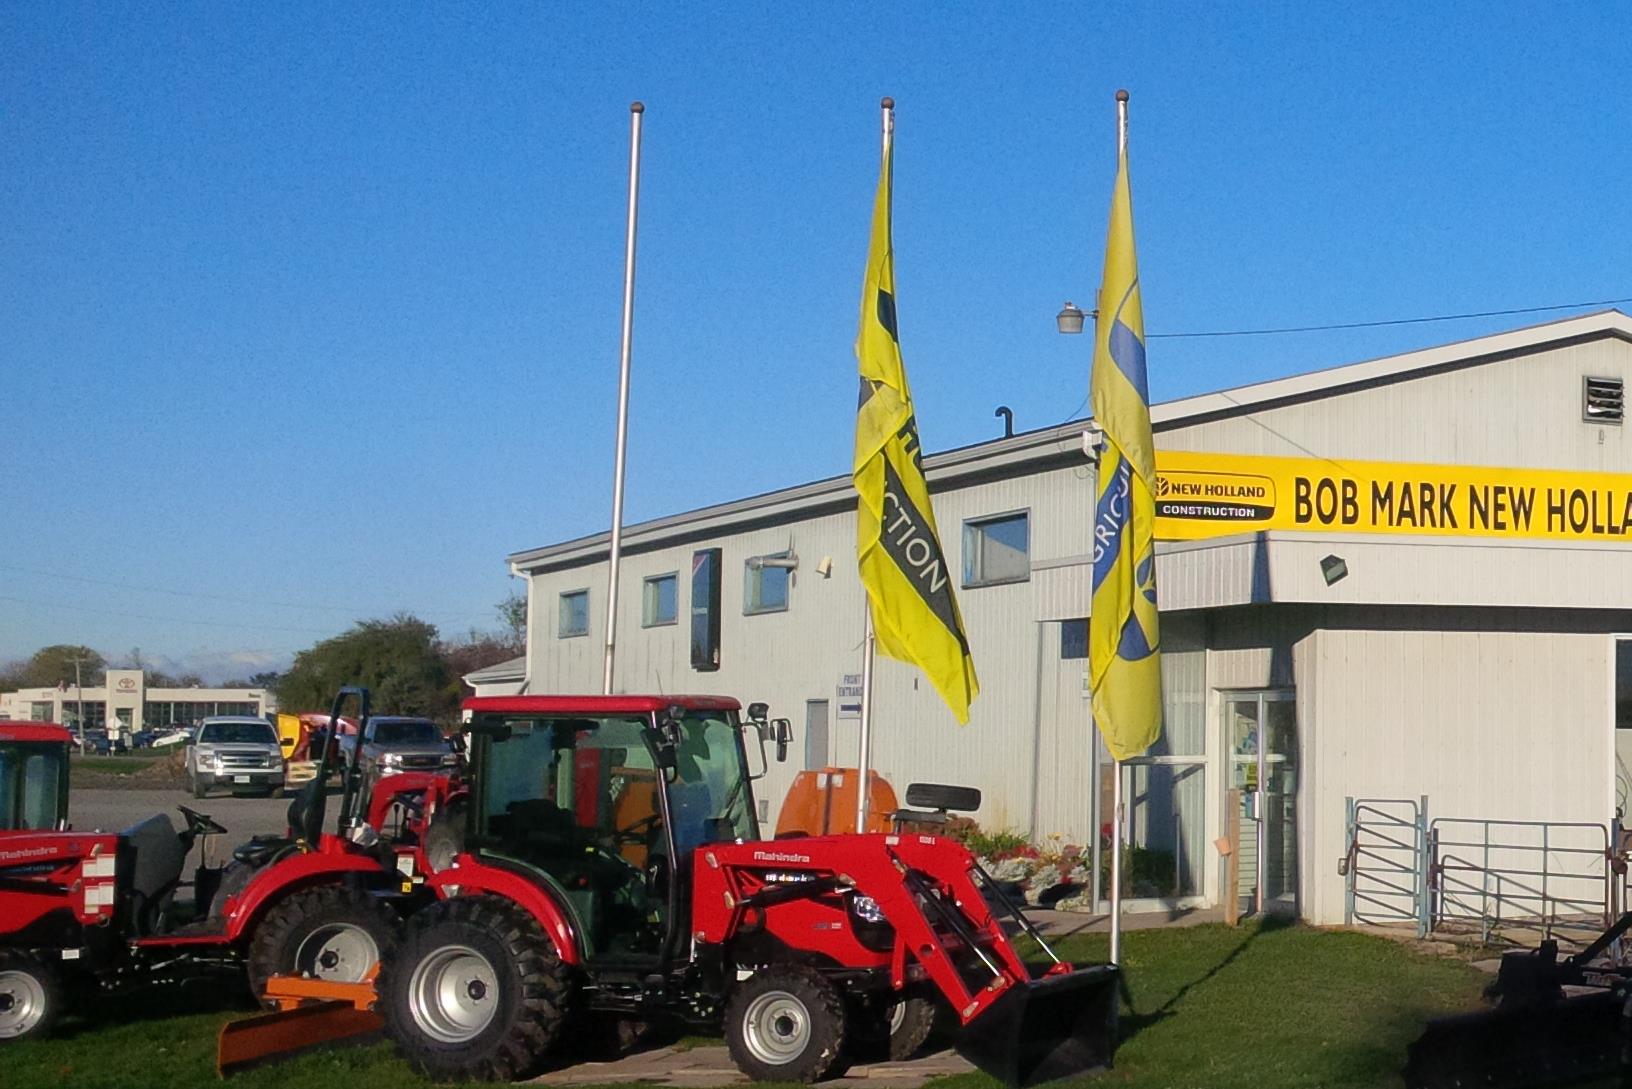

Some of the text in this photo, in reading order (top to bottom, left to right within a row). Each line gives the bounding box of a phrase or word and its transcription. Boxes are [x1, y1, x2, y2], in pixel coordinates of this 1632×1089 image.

[1171, 483, 1265, 498] NEW HOLLAND
[1162, 505, 1255, 518] CONSTRUCTION
[1295, 477, 1359, 525] BOB
[1371, 480, 1458, 529] MARK
[1469, 484, 1536, 532] NEW
[753, 851, 810, 863] Mahindra
